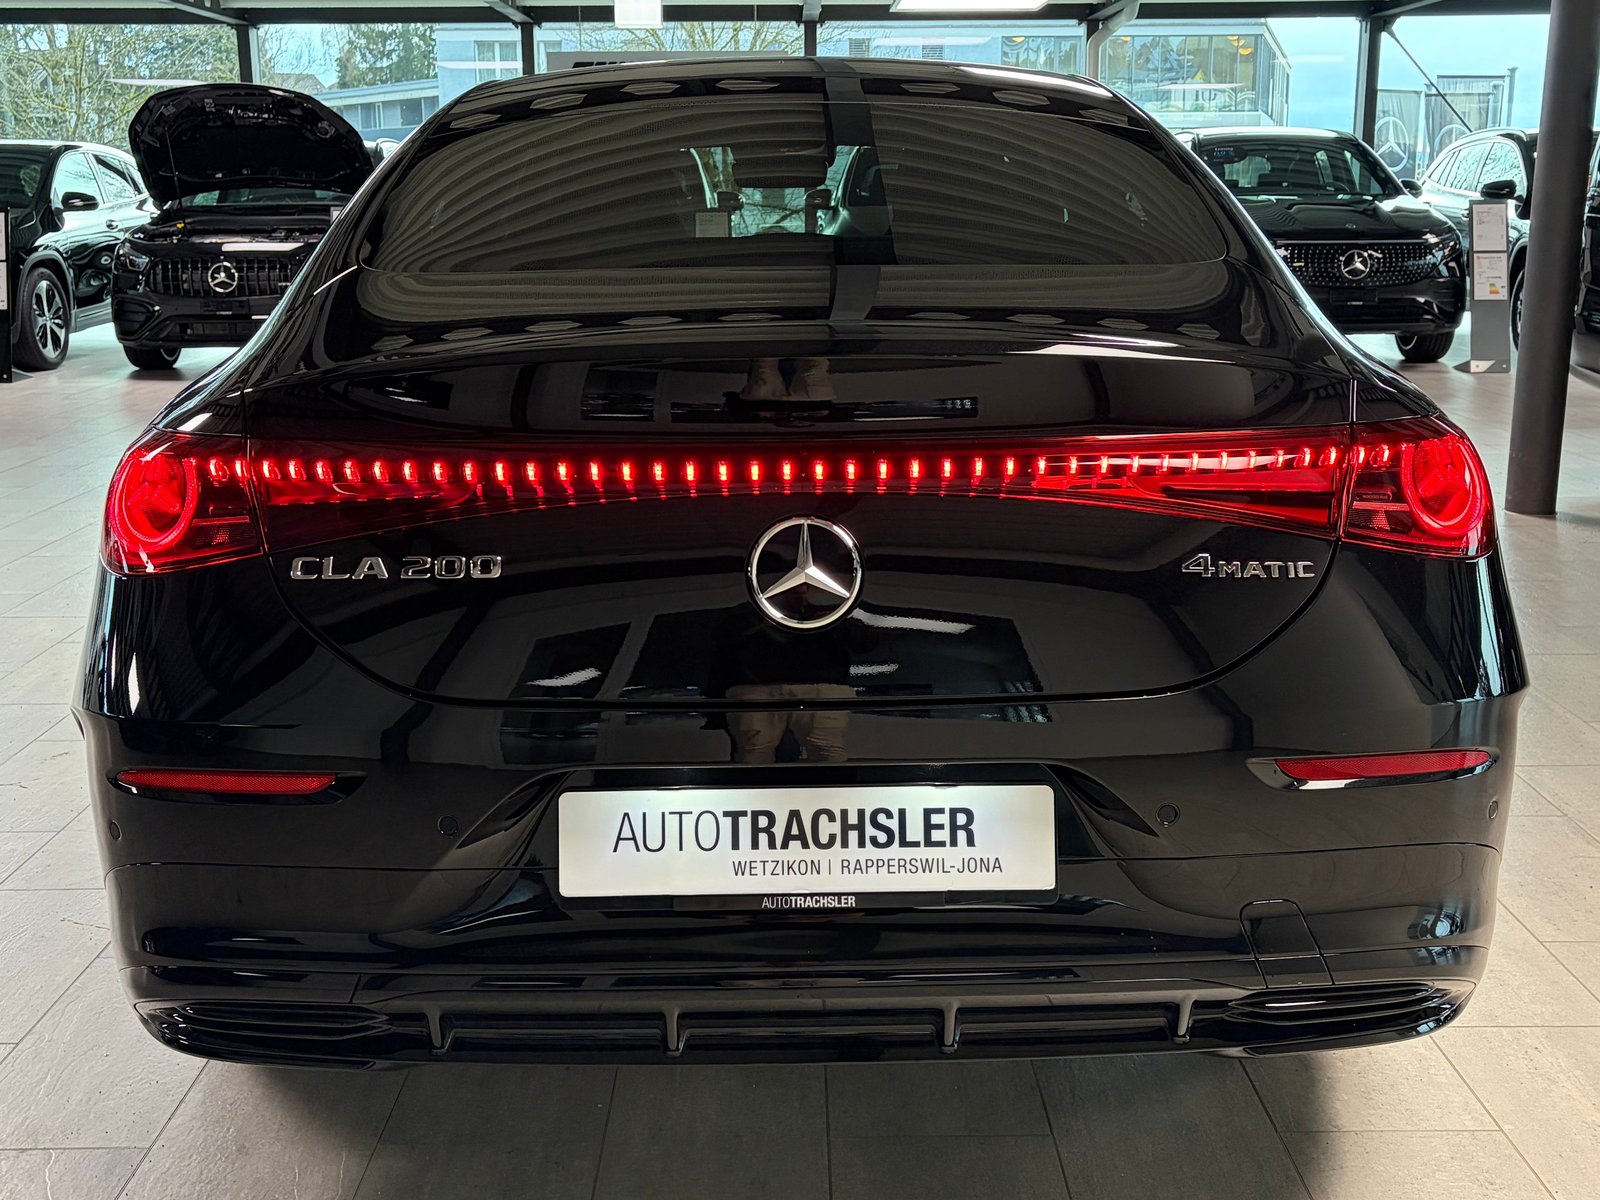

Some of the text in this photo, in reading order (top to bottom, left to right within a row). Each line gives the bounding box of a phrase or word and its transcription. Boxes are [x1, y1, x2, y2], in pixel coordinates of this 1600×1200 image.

[290, 556, 502, 580] CLA 200
[1181, 553, 1315, 578] 4MATIC
[612, 807, 976, 853] AUTOTRACHSLER
[732, 859, 821, 877] WETZIKON
[840, 856, 1004, 875] RAPPERSWIL-JONA
[761, 895, 856, 909] AUTOTRACHSLER
